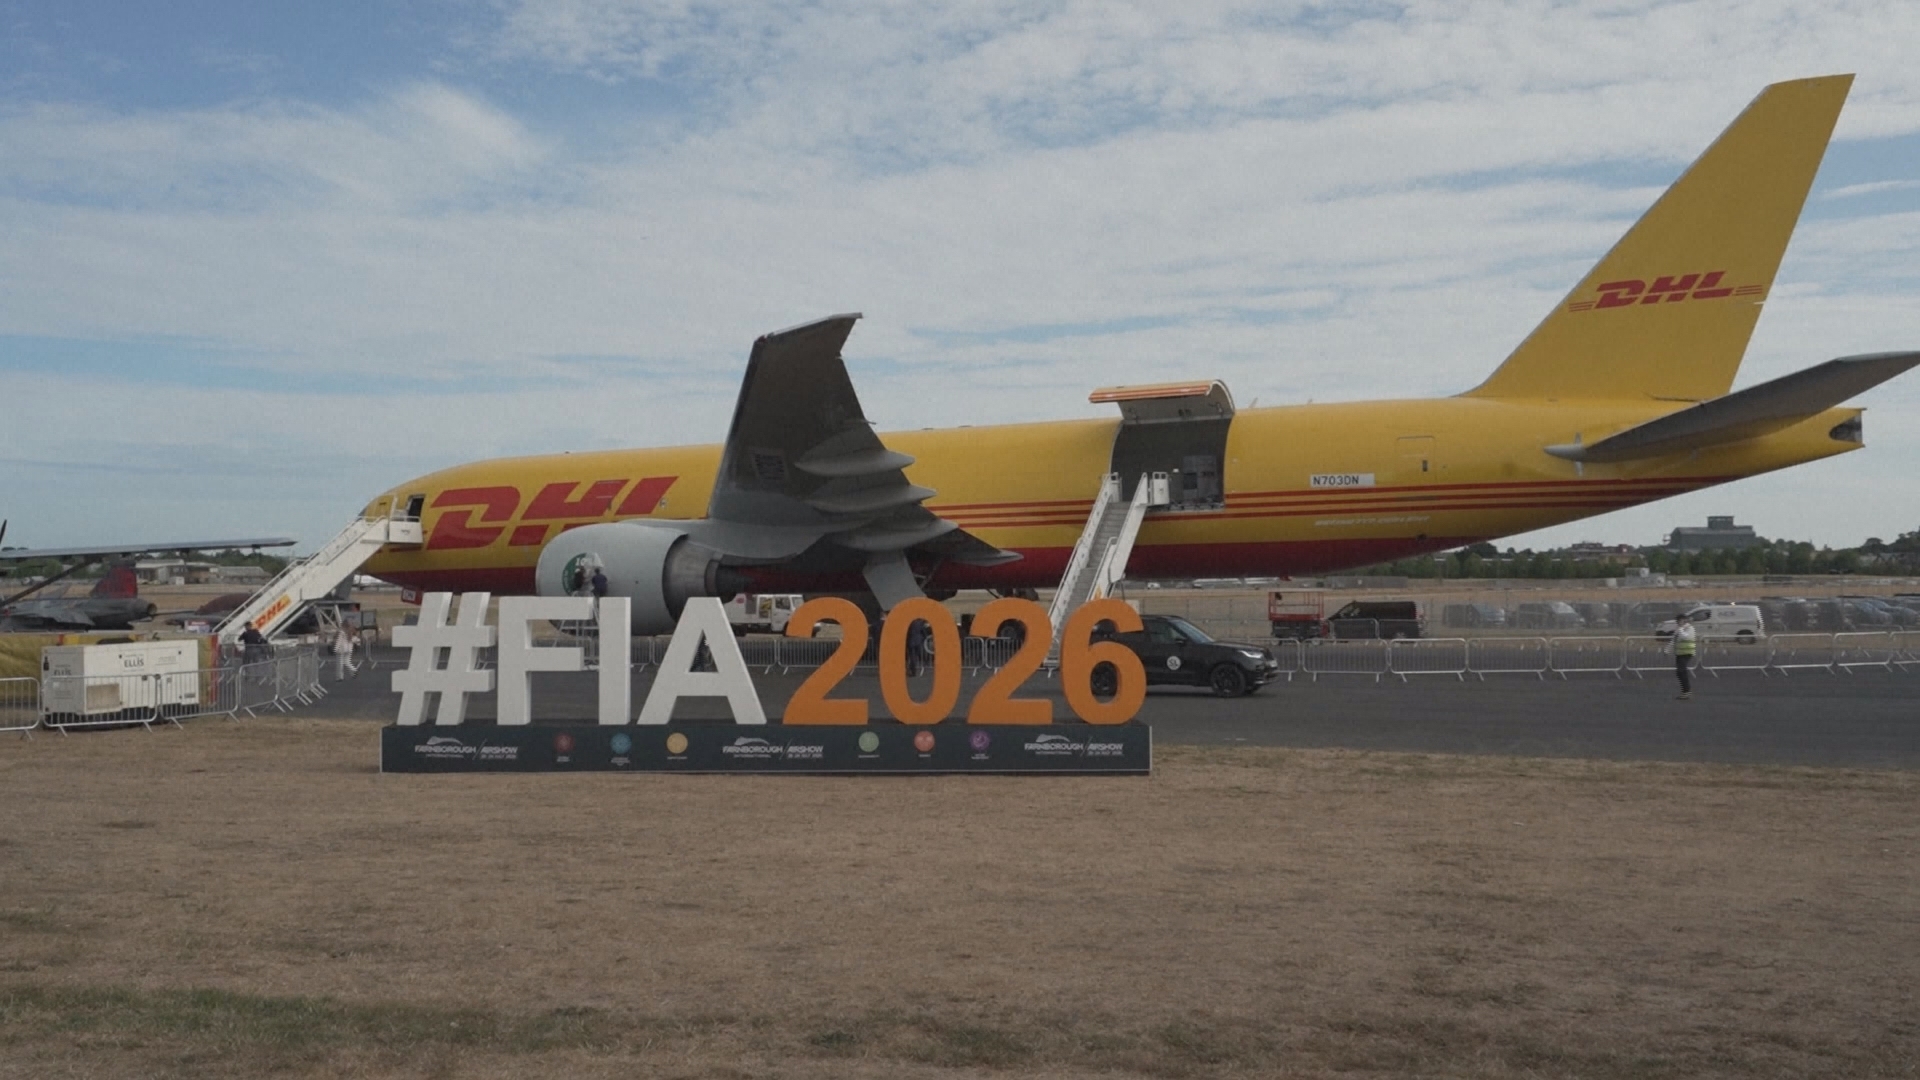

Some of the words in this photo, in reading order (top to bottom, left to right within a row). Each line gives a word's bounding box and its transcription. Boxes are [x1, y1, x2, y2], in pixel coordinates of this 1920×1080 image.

[1594, 270, 1734, 309] DHL
[1312, 475, 1360, 486] N703DN
[255, 600, 285, 629] DHL
[415, 745, 477, 754] FARNBOROUGH
[481, 746, 518, 754] AIRSHOW
[723, 745, 783, 753] FARNBOROUGH
[1024, 743, 1083, 751] FARNBOROUGH
